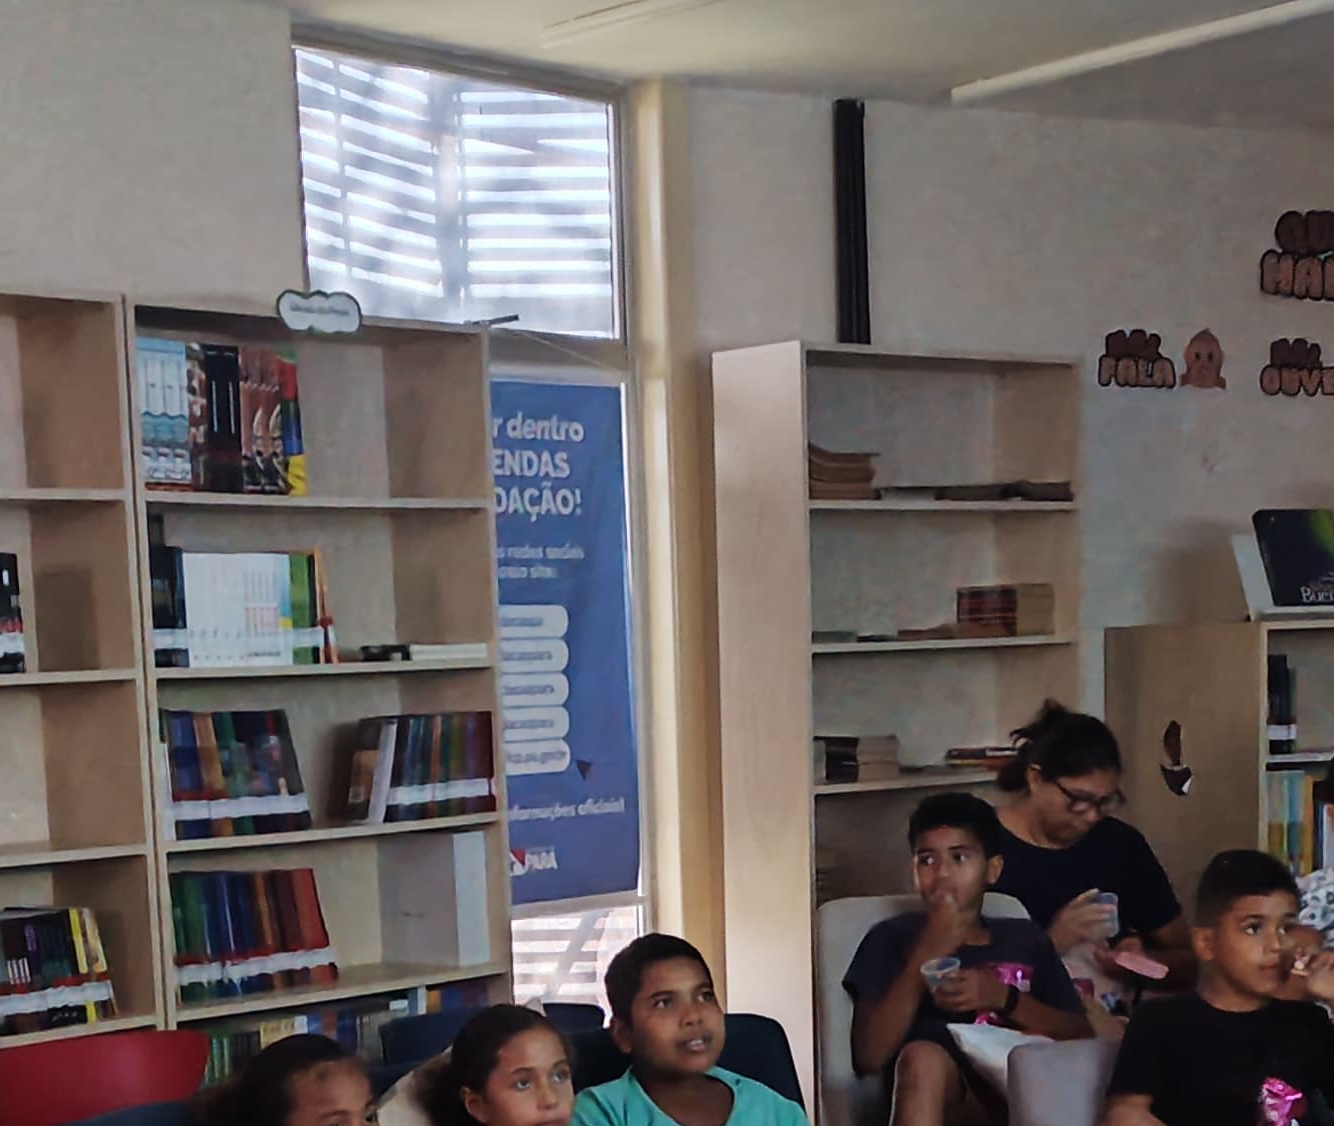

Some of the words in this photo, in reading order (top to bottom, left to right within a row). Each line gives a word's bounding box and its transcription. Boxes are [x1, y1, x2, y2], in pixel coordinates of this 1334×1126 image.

[1098, 353, 1177, 388] FALA
[507, 411, 585, 442] dentro
[493, 448, 571, 479] ENDAS
[494, 481, 582, 523] DAÇÃO!
[508, 802, 576, 822] nformações
